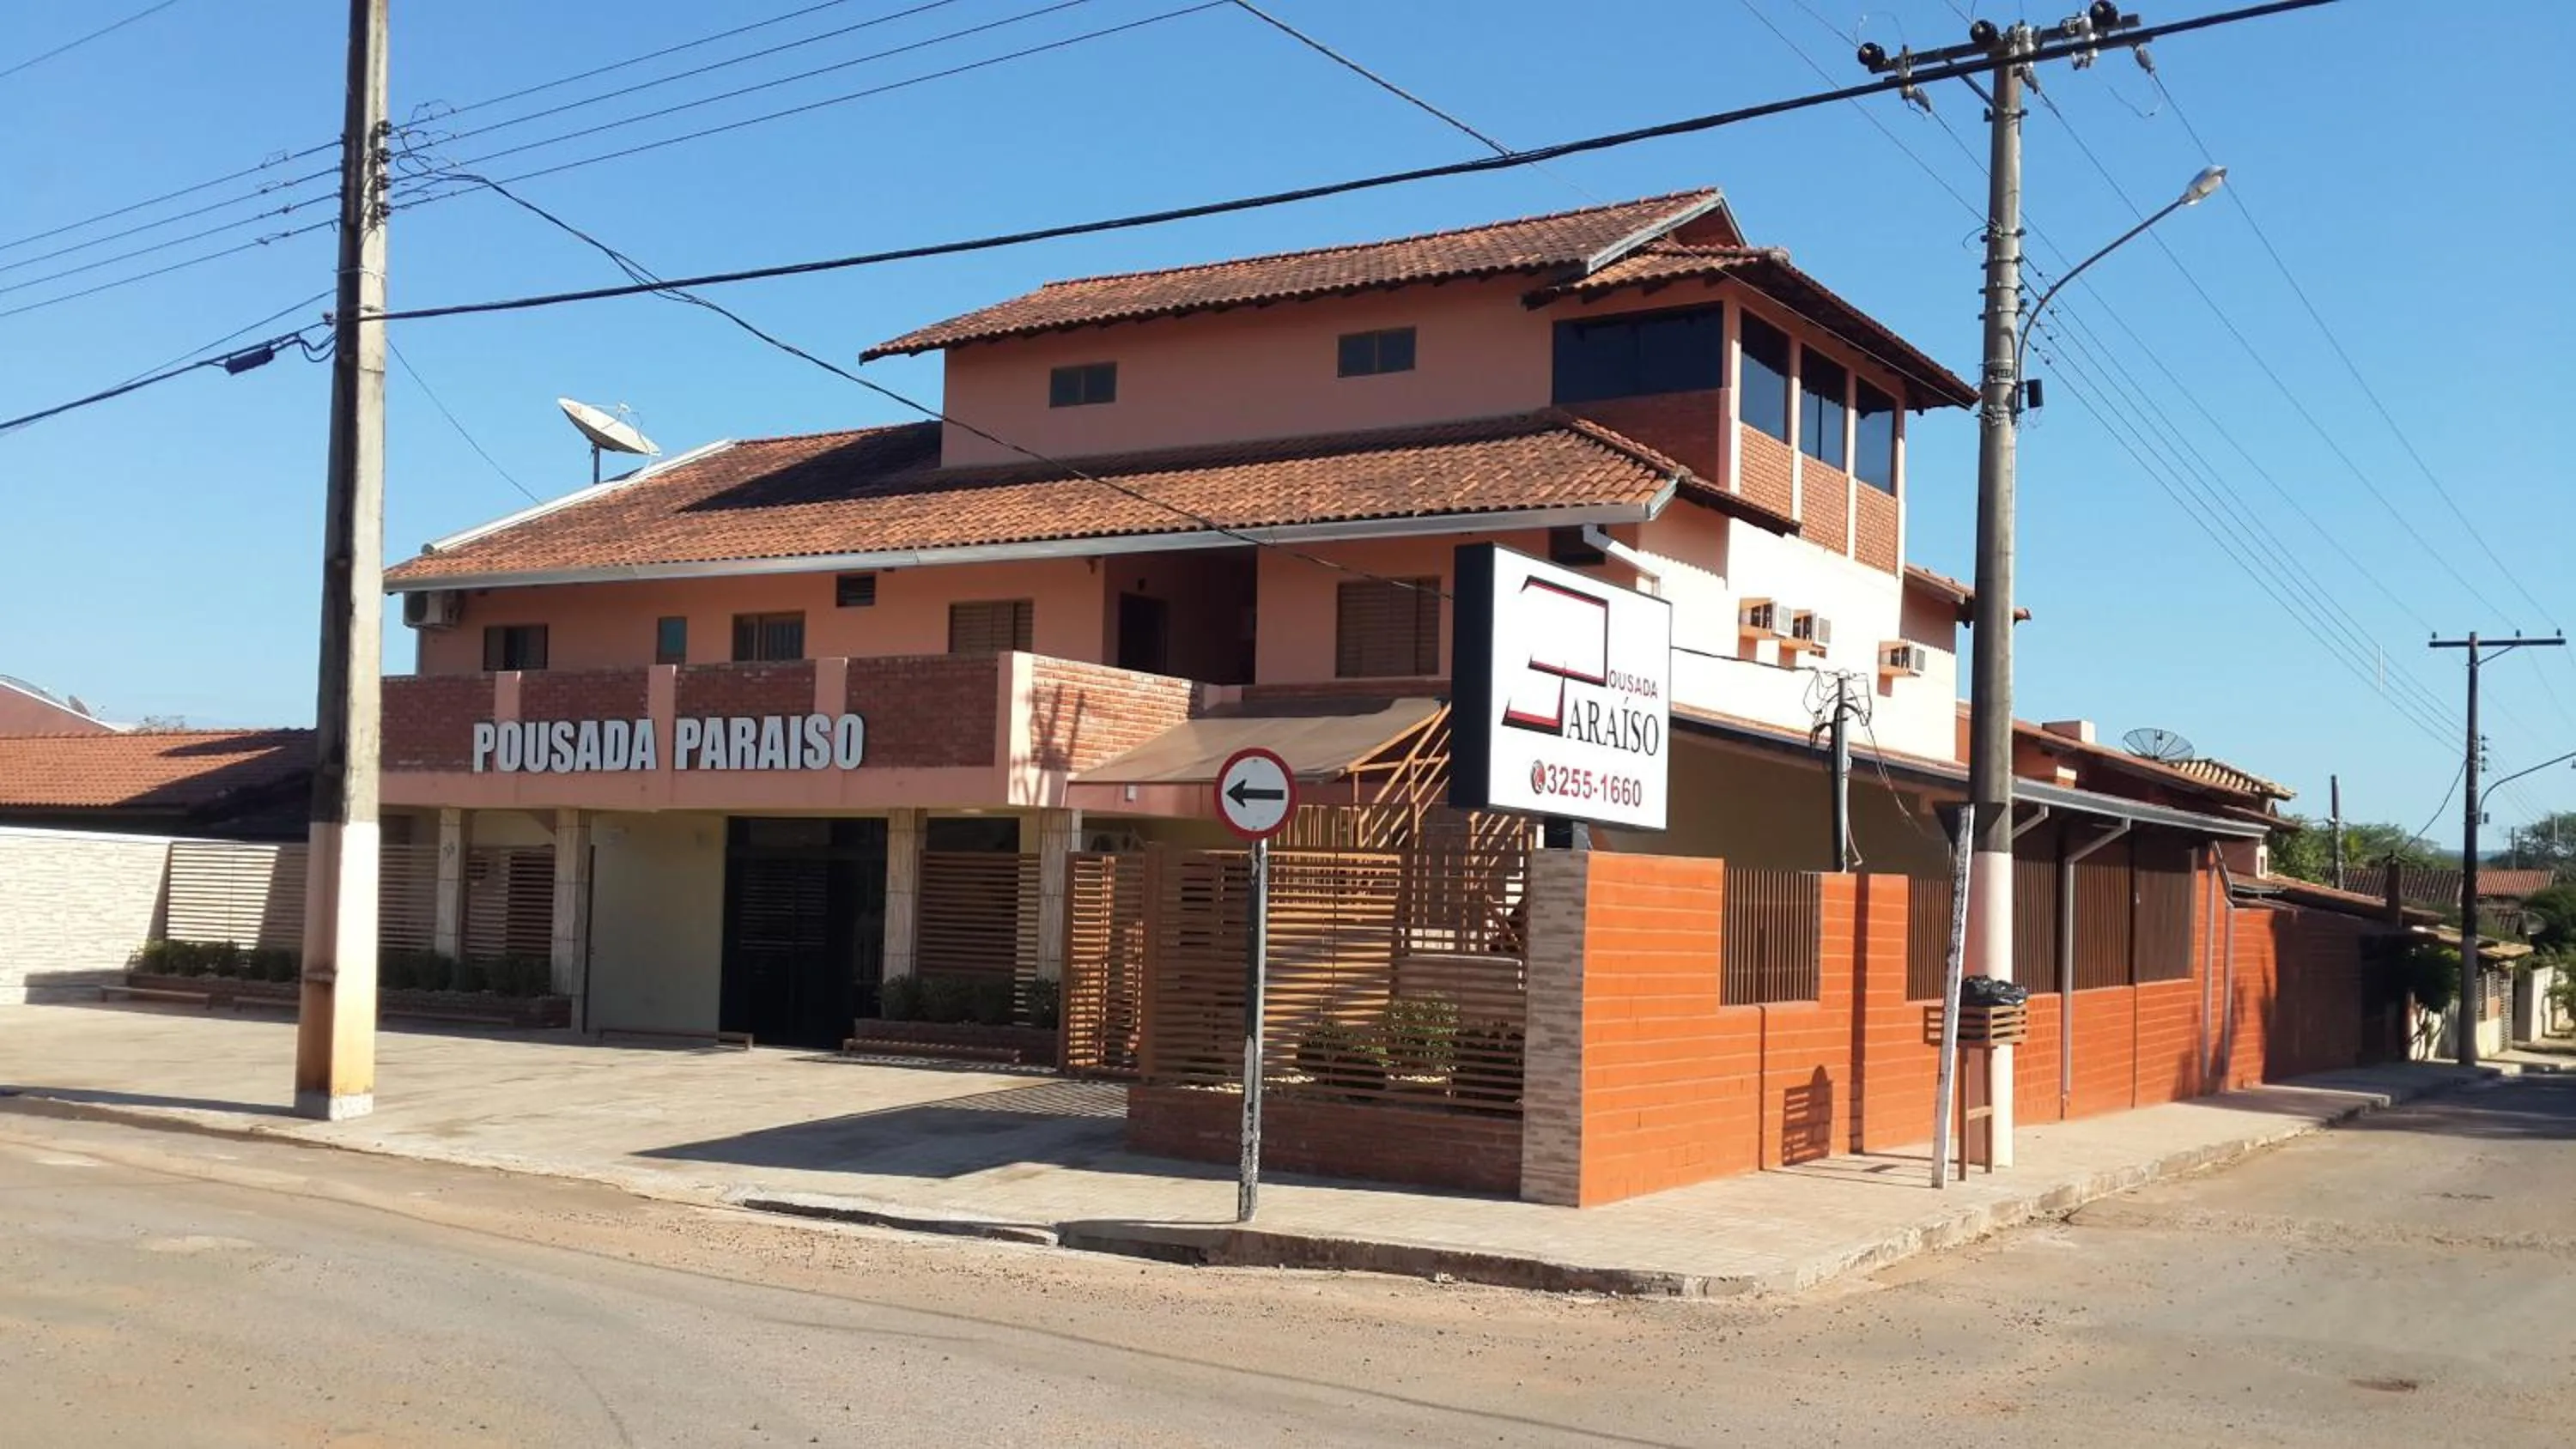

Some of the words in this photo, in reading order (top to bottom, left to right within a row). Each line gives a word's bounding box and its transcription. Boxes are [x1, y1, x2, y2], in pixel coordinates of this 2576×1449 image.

[473, 718, 657, 773] POUSADA
[675, 713, 865, 770] PARAISO
[1546, 763, 1643, 808] 3255-1660
